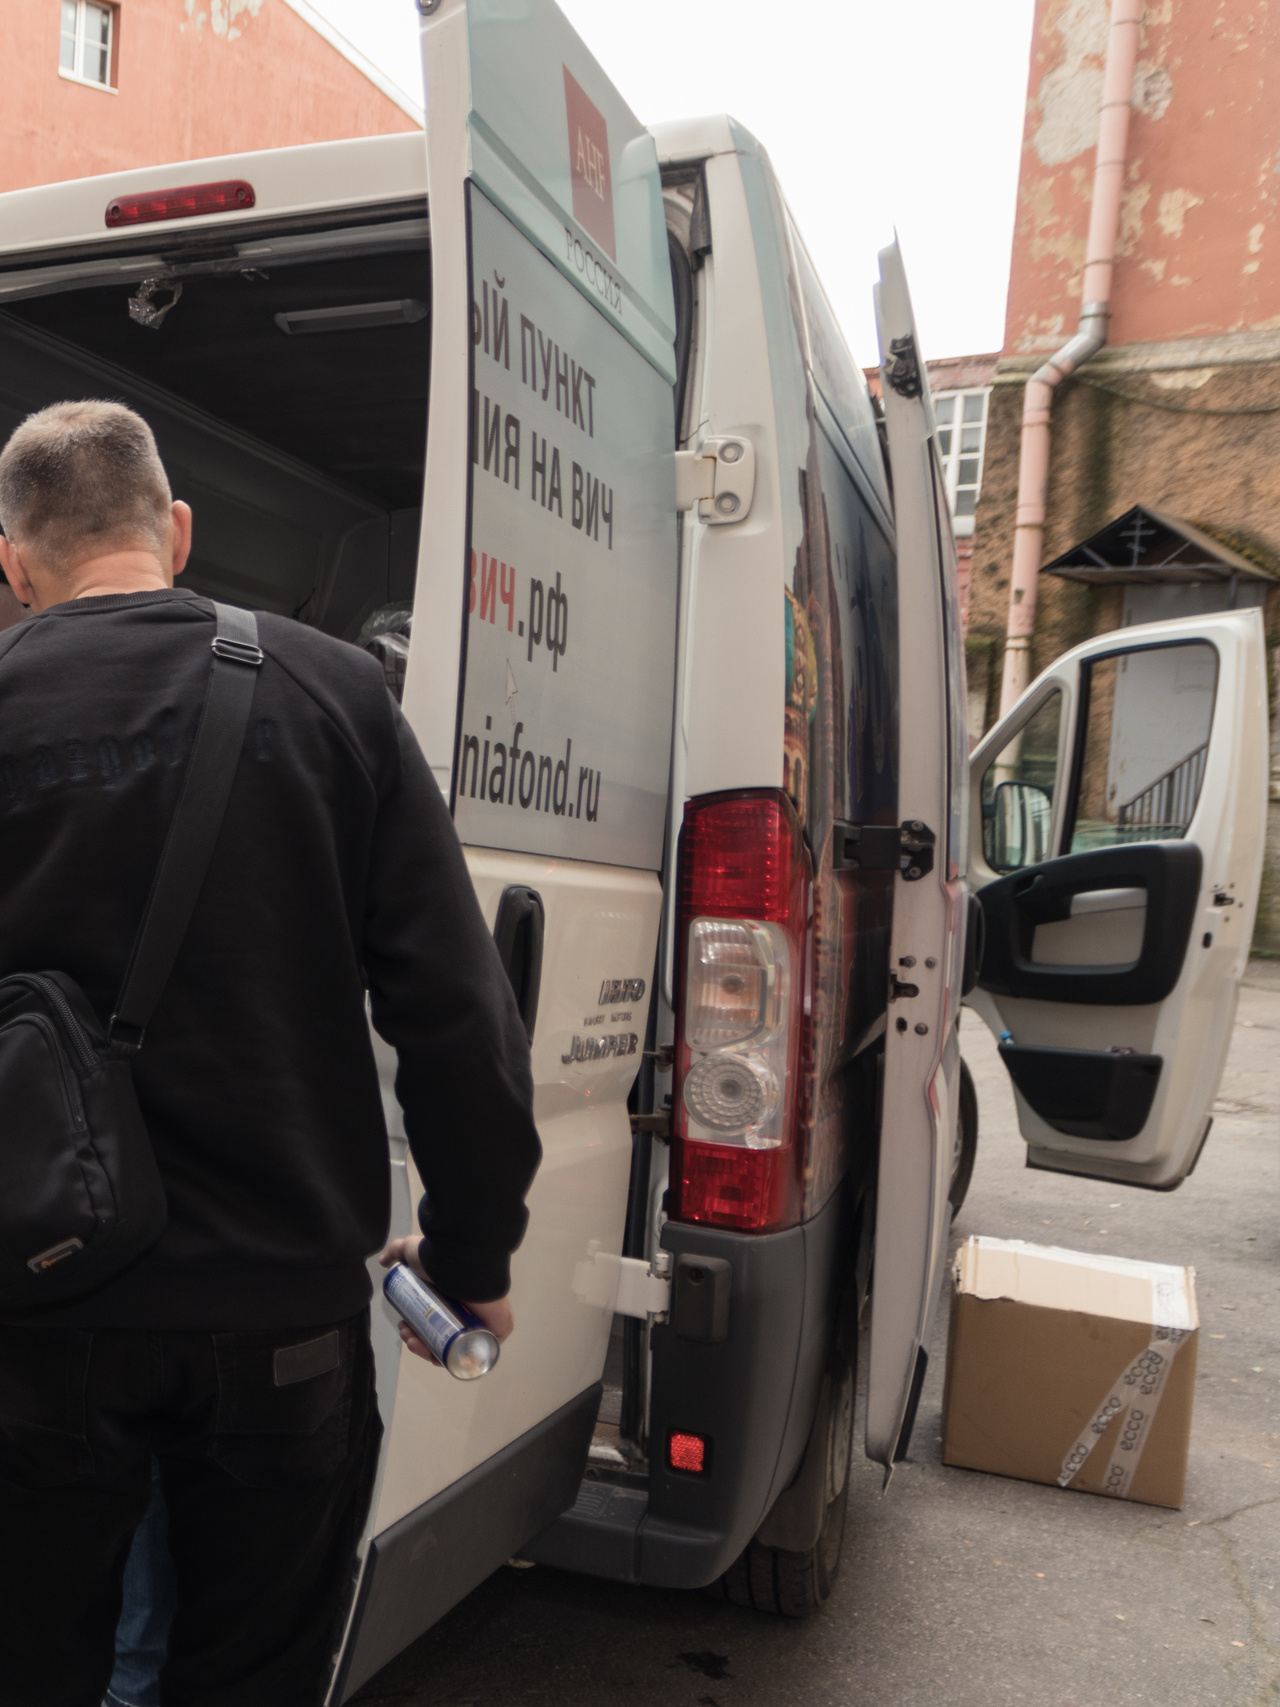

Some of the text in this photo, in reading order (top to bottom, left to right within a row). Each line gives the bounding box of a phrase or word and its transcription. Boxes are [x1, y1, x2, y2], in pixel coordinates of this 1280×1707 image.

[565, 226, 623, 316] РОССИЯ
[521, 312, 596, 438] ПУНКТ
[532, 430, 563, 519] НА
[572, 460, 613, 550] ВИЧ
[459, 715, 601, 822] niafond.ru
[1091, 1396, 1121, 1434] ecco
[1120, 1409, 1144, 1451] ecco
